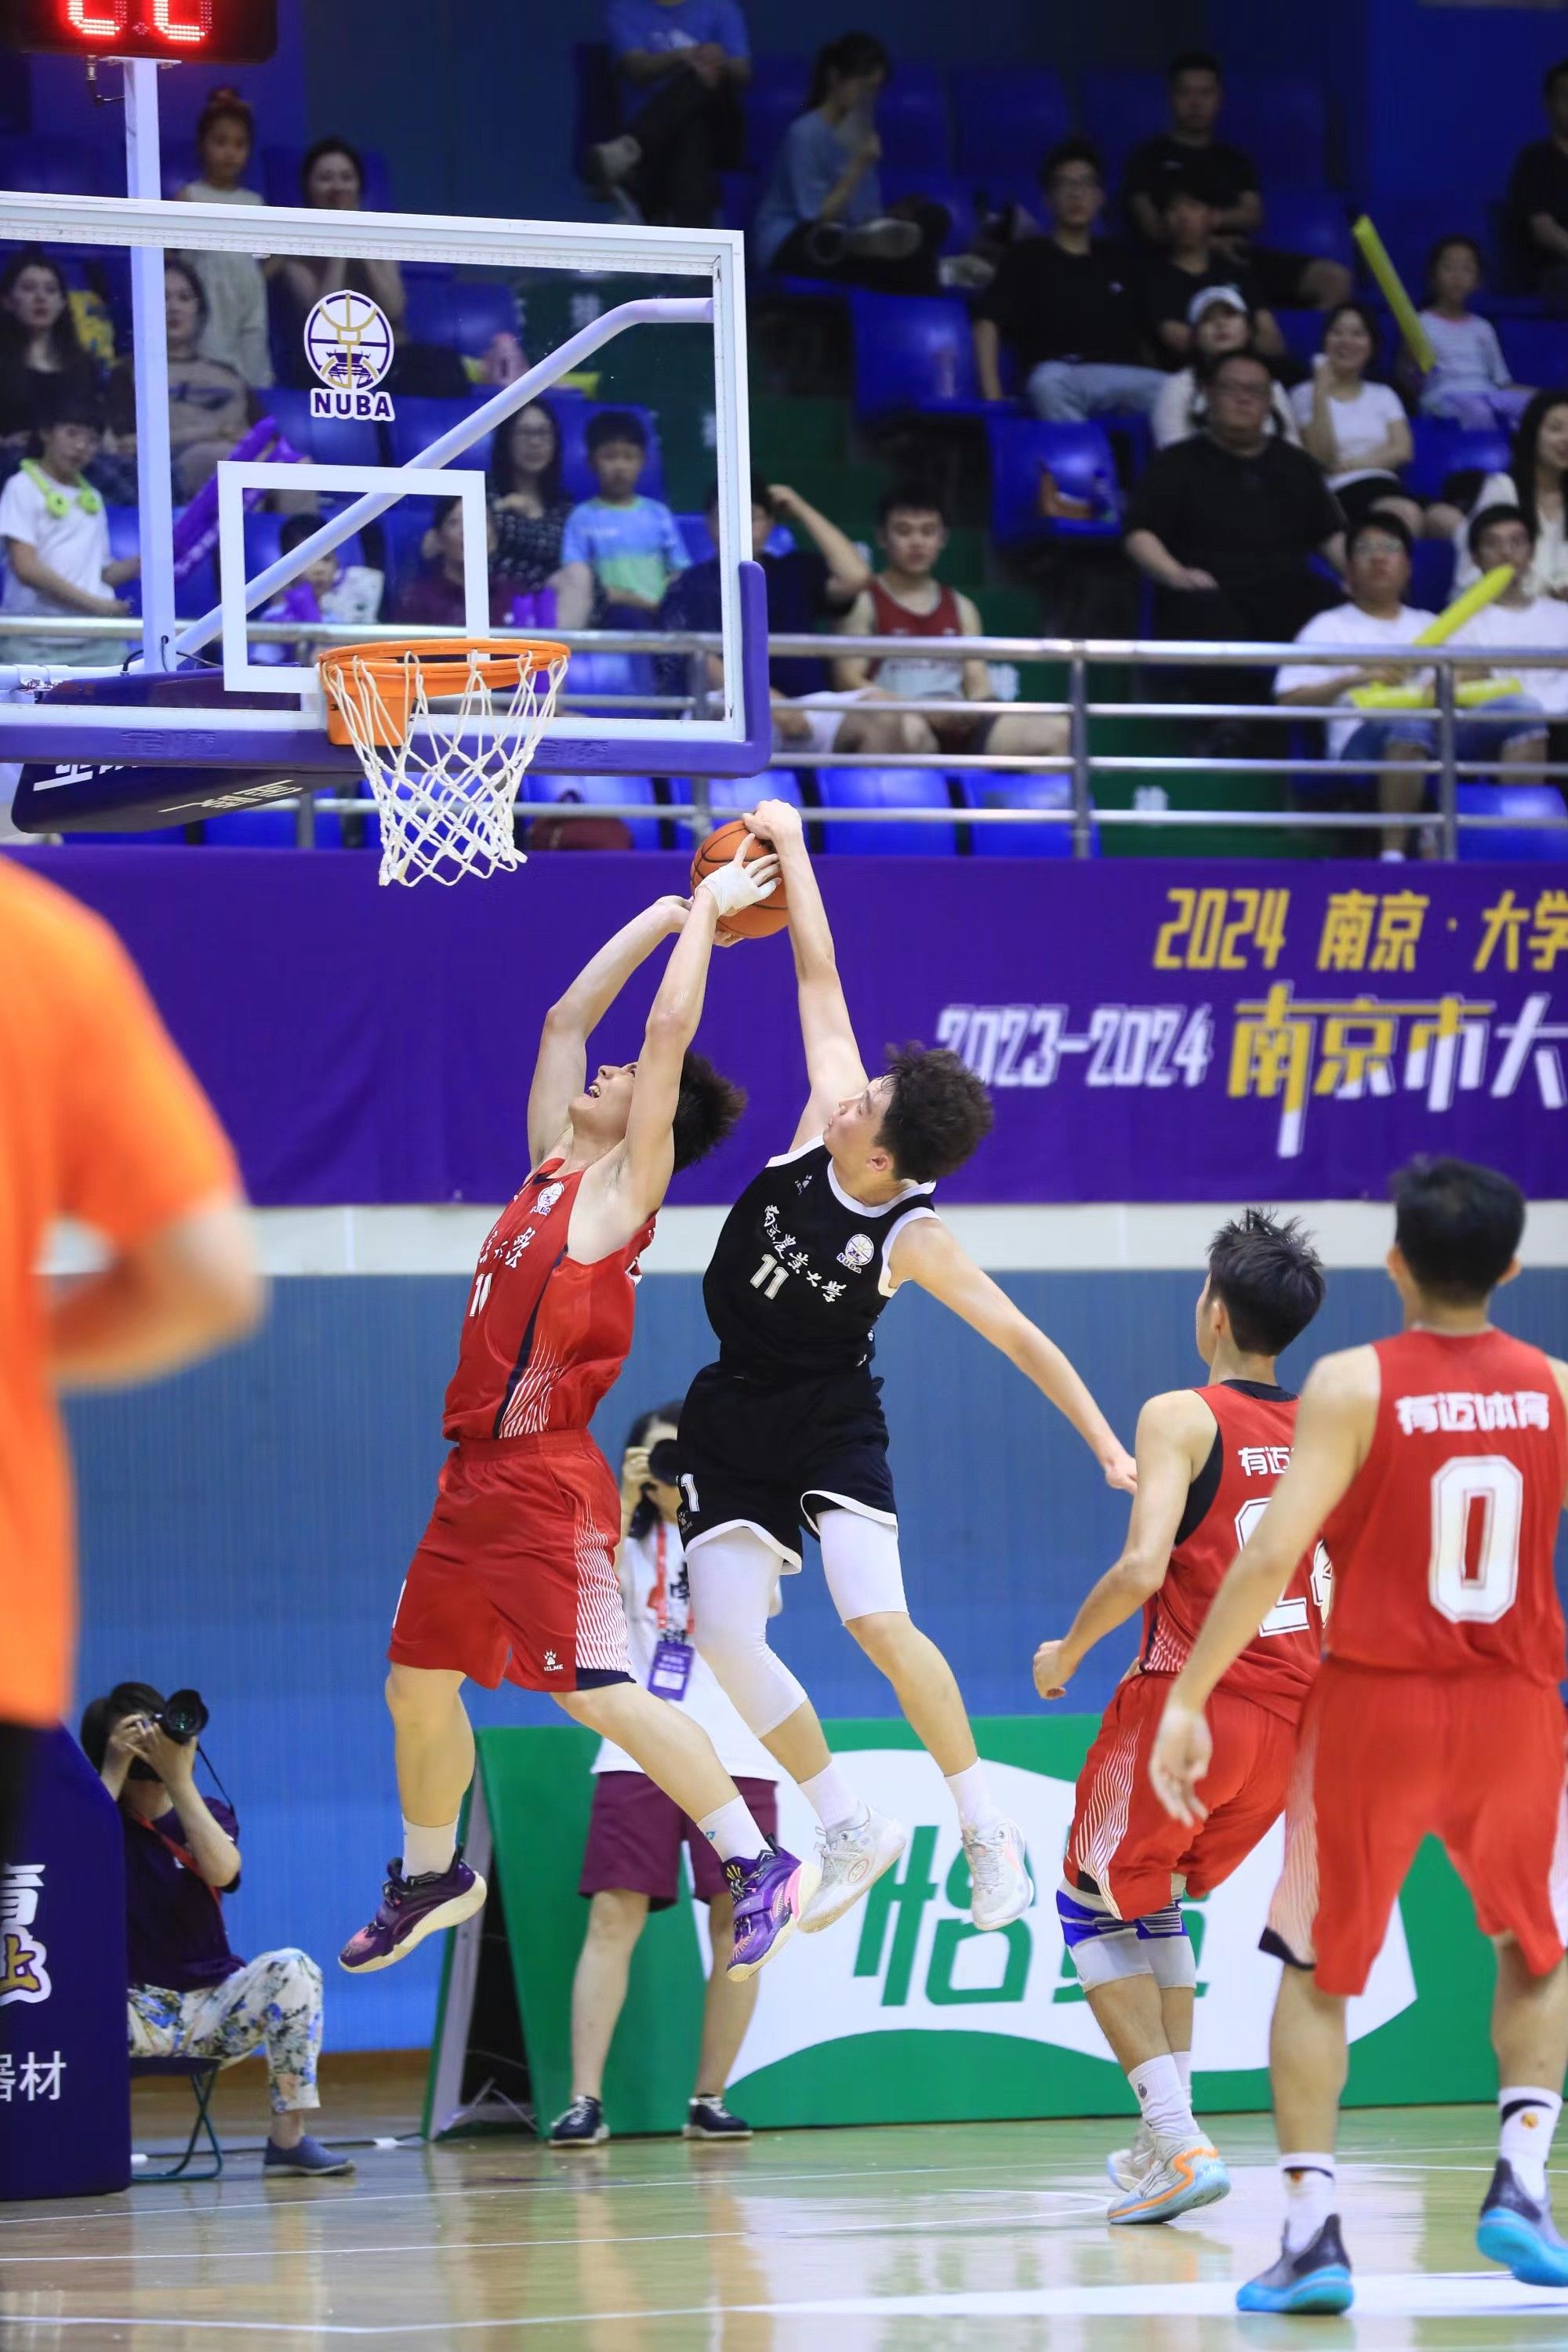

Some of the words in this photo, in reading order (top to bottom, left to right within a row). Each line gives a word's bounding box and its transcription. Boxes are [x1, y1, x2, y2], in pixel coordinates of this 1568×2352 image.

[314, 392, 391, 417] NUBA
[1152, 888, 1290, 969] 2024
[750, 1254, 789, 1300] 11
[837, 1253, 862, 1274] NUBA
[1238, 1446, 1294, 1477] 有迈
[1428, 1454, 1523, 1624] 0
